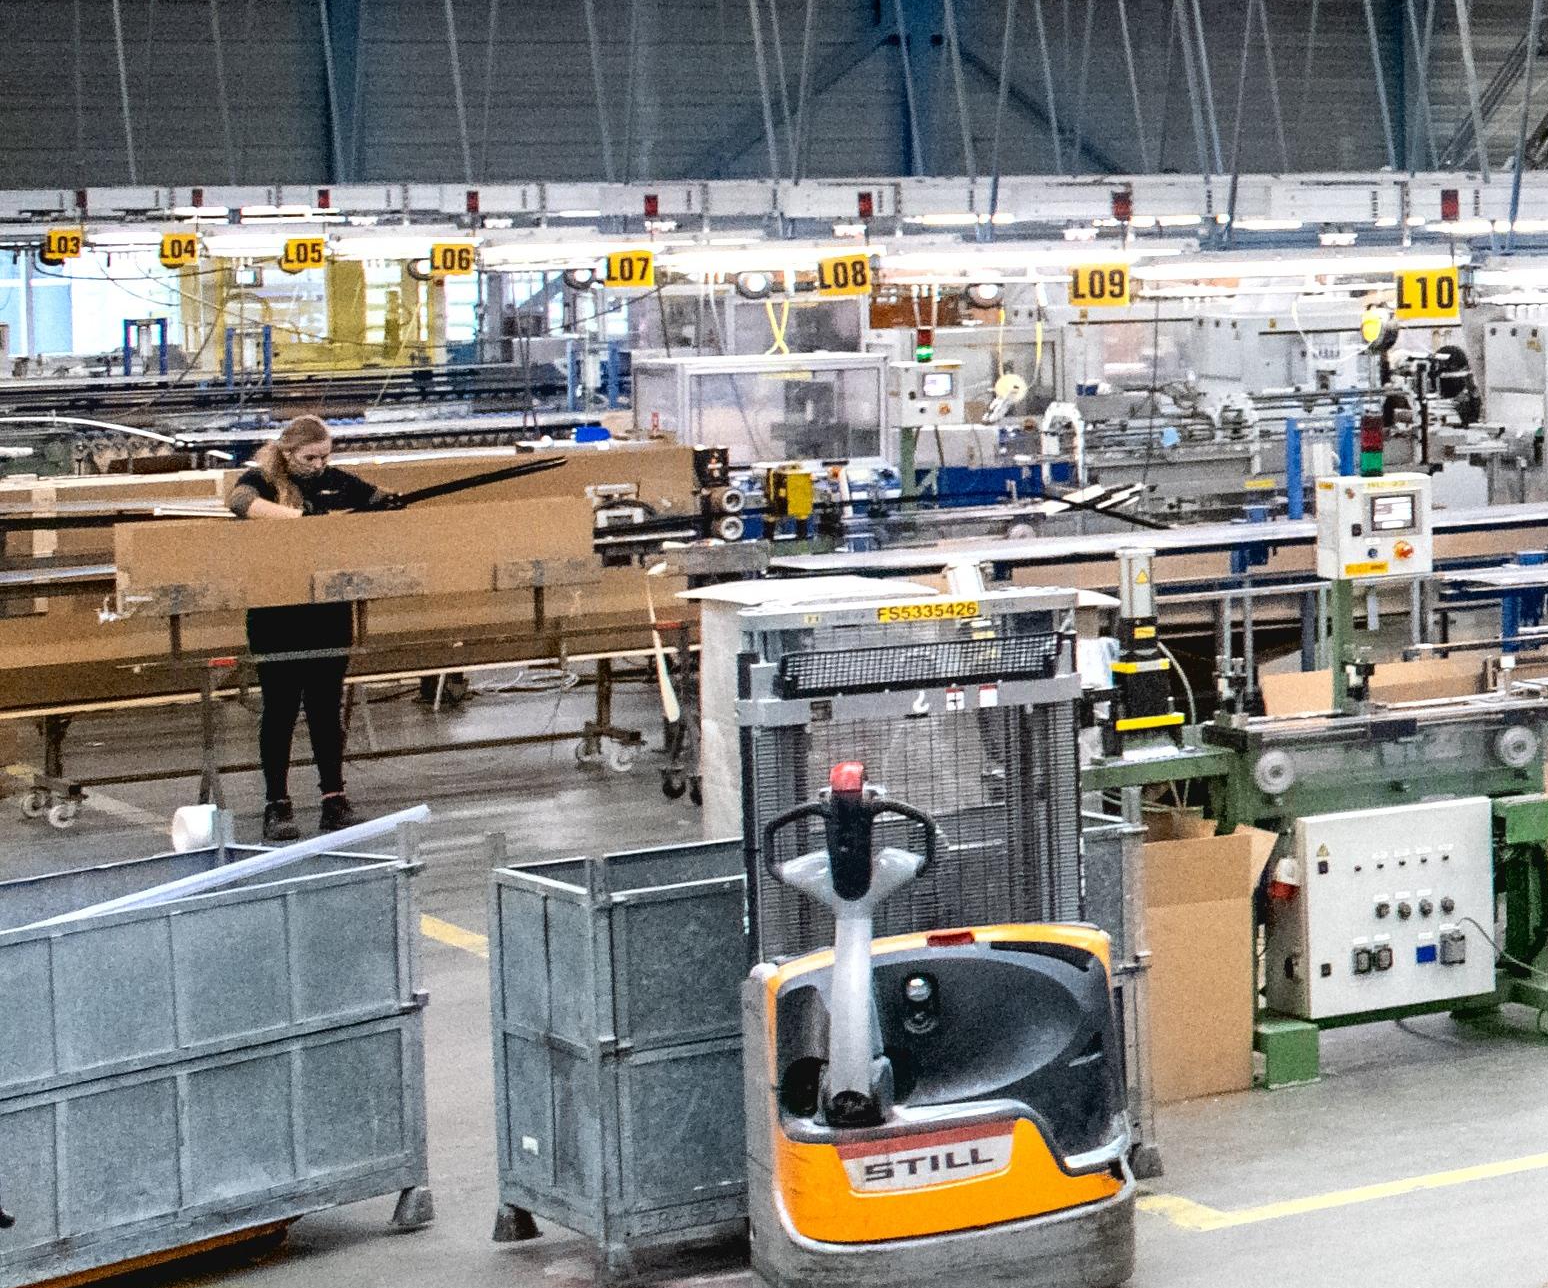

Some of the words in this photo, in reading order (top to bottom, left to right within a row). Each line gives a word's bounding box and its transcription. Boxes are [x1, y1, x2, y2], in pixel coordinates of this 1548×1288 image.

[47, 235, 80, 254] L03
[161, 242, 195, 259] L04
[284, 243, 323, 264] L05
[432, 248, 472, 271] L06
[608, 256, 651, 284] L07
[818, 259, 866, 290] L08
[1071, 267, 1126, 301] L09
[1397, 274, 1455, 310] L10
[876, 601, 977, 622] FS5335426
[864, 1147, 994, 1182] STILL
